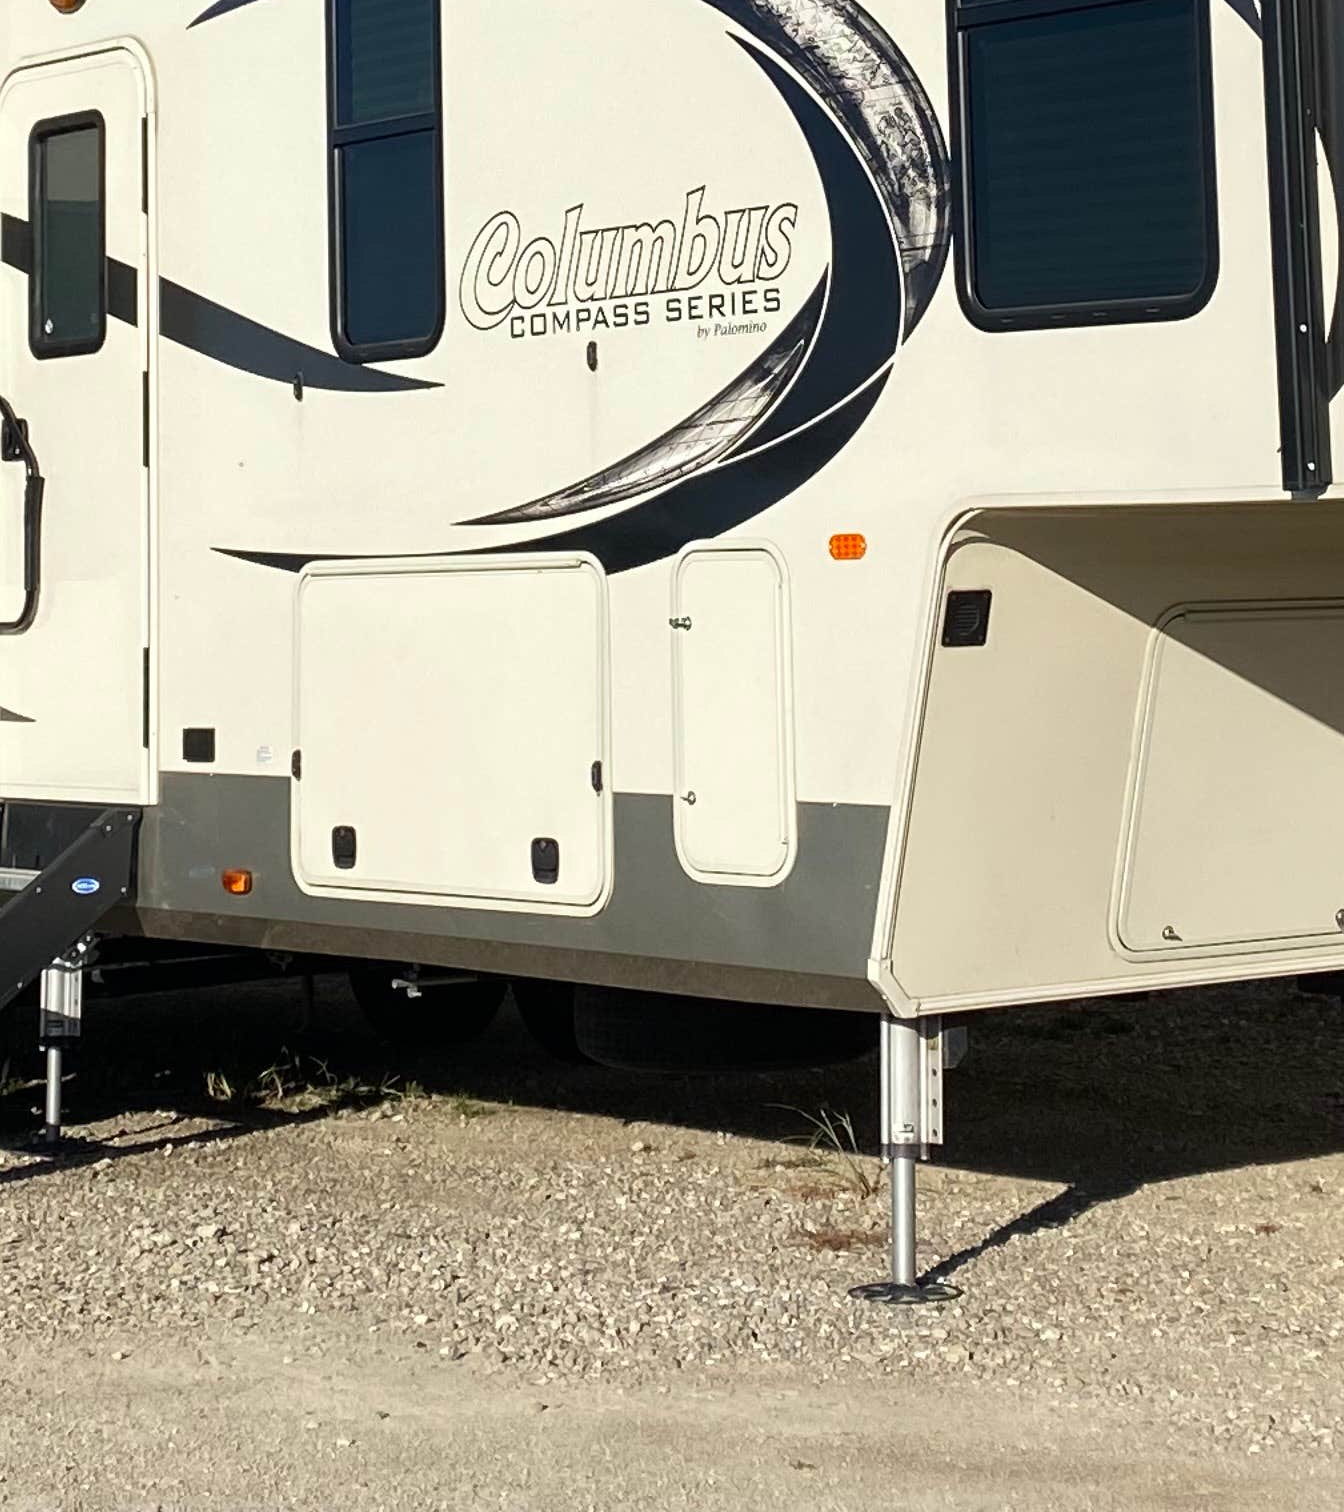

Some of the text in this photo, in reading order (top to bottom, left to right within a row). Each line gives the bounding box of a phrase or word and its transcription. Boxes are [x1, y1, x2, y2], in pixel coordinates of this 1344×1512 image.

[459, 185, 799, 330] Columbus
[510, 289, 781, 339] COMPASS SERIES
[696, 320, 768, 339] by Palomino
